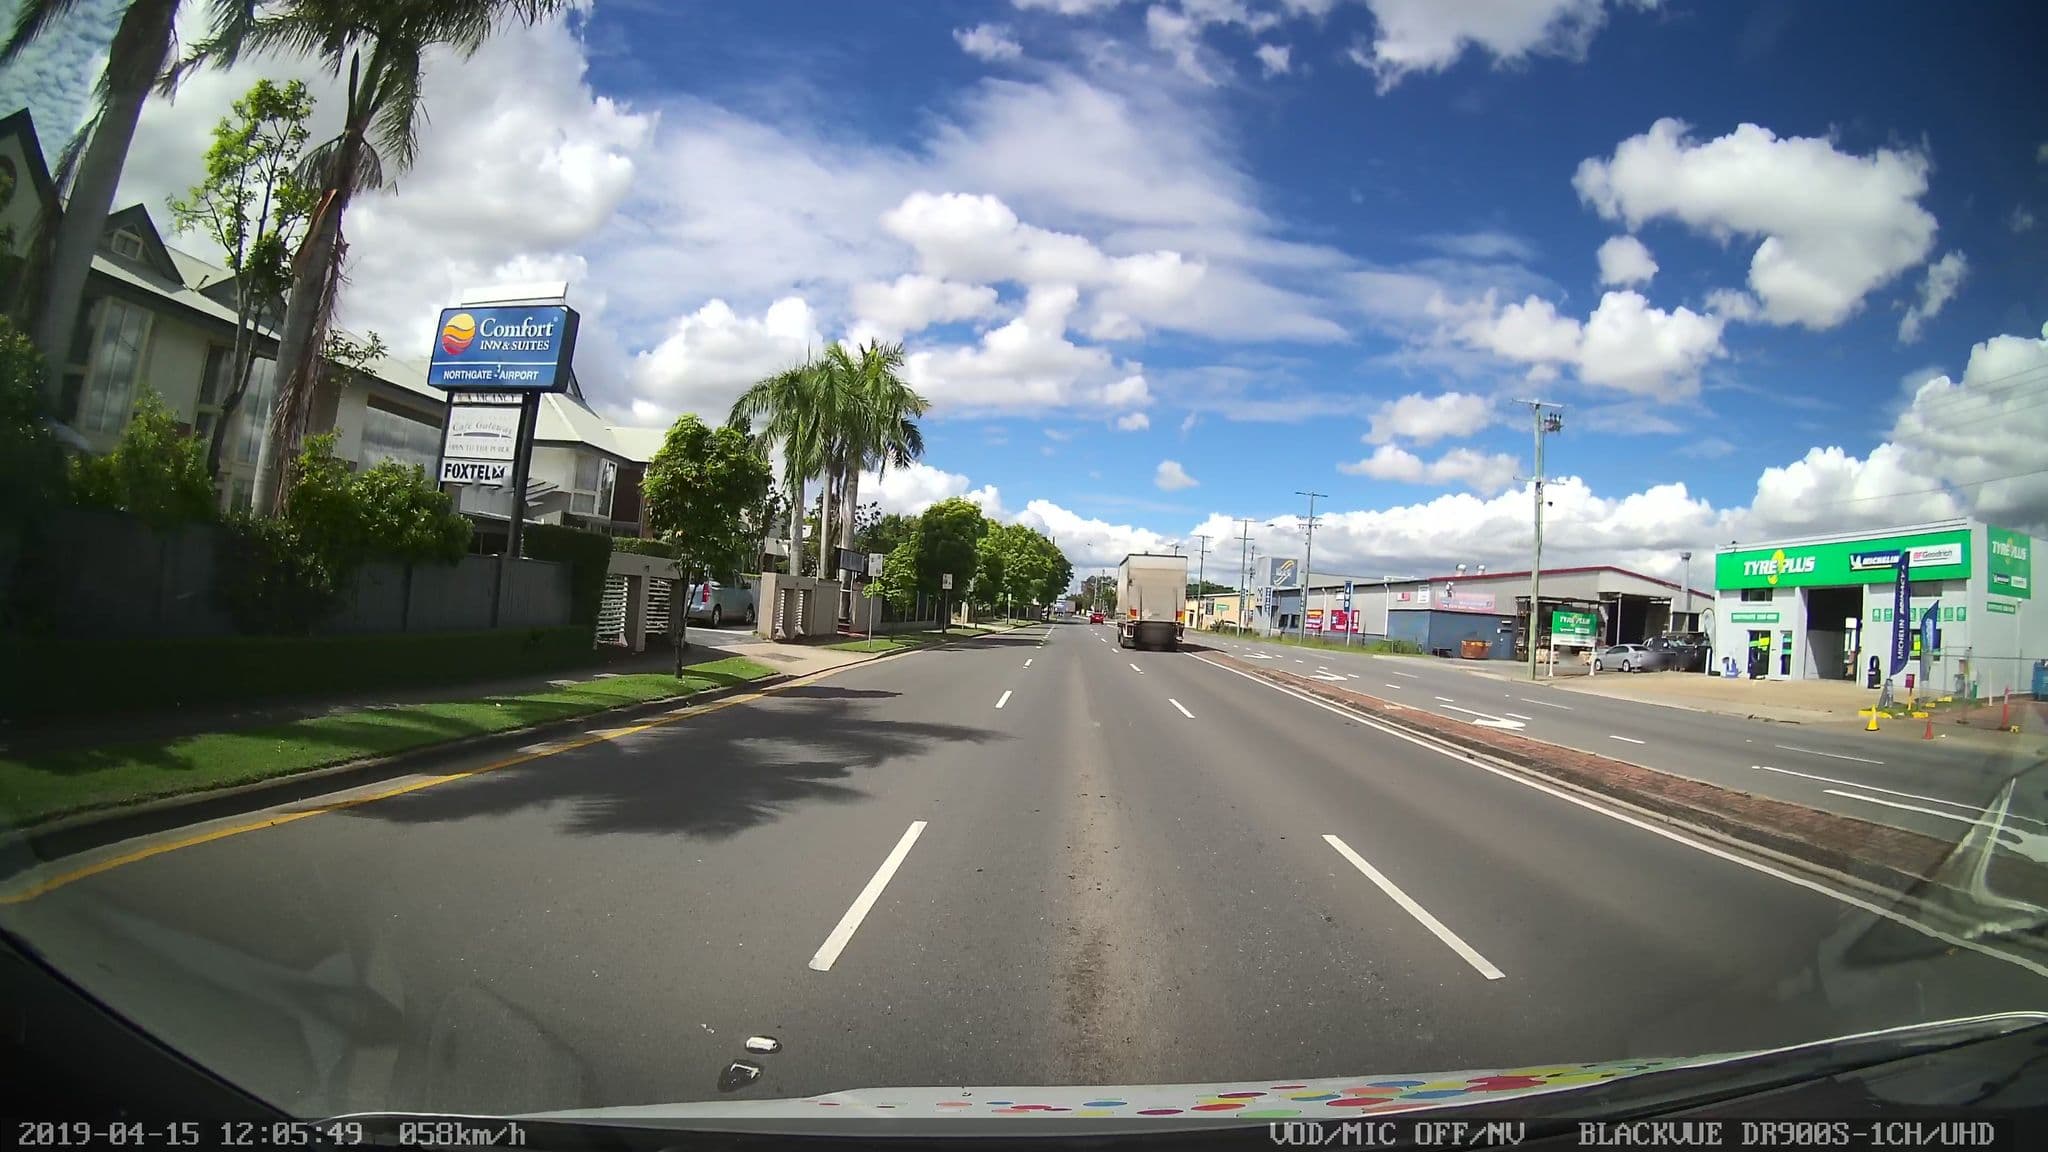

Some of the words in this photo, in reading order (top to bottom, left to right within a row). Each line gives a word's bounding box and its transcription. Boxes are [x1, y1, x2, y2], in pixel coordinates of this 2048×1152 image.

[480, 316, 554, 338] Comfort
[480, 340, 502, 350] INN
[502, 341, 510, 351] &
[511, 340, 550, 351] SUITES
[443, 370, 493, 380] NORTHGATE
[498, 370, 540, 380] AIRPORT
[444, 463, 491, 480] FOXTEL
[1862, 555, 1900, 566] MICHELIN
[1897, 619, 1905, 660] MICHELIN
